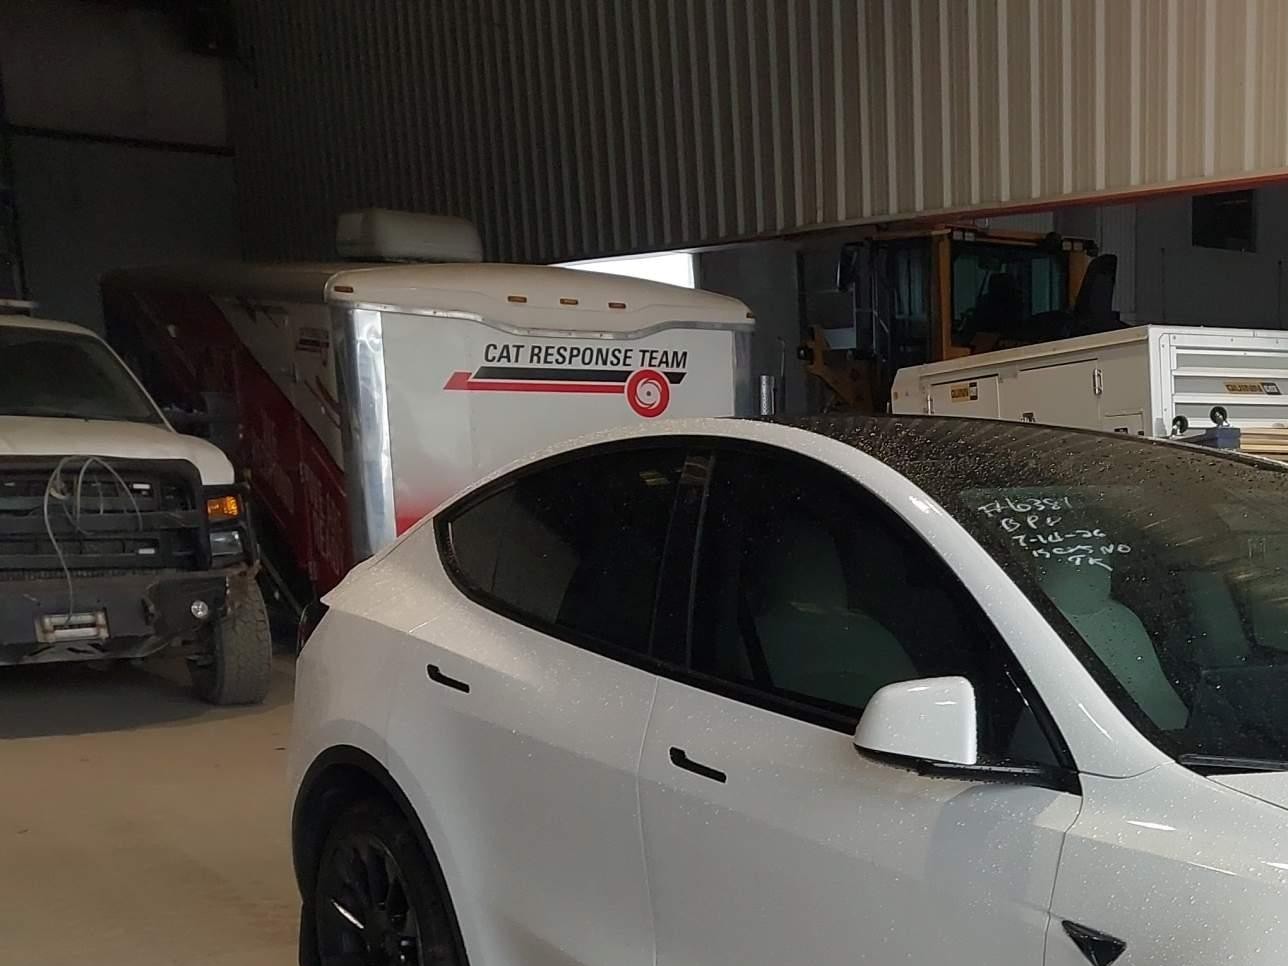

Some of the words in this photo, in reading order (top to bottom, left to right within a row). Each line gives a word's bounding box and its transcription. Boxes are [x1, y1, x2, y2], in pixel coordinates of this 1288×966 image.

[484, 343, 525, 363] CAT
[529, 345, 633, 367] RESPONSE
[638, 349, 688, 369] TEAM
